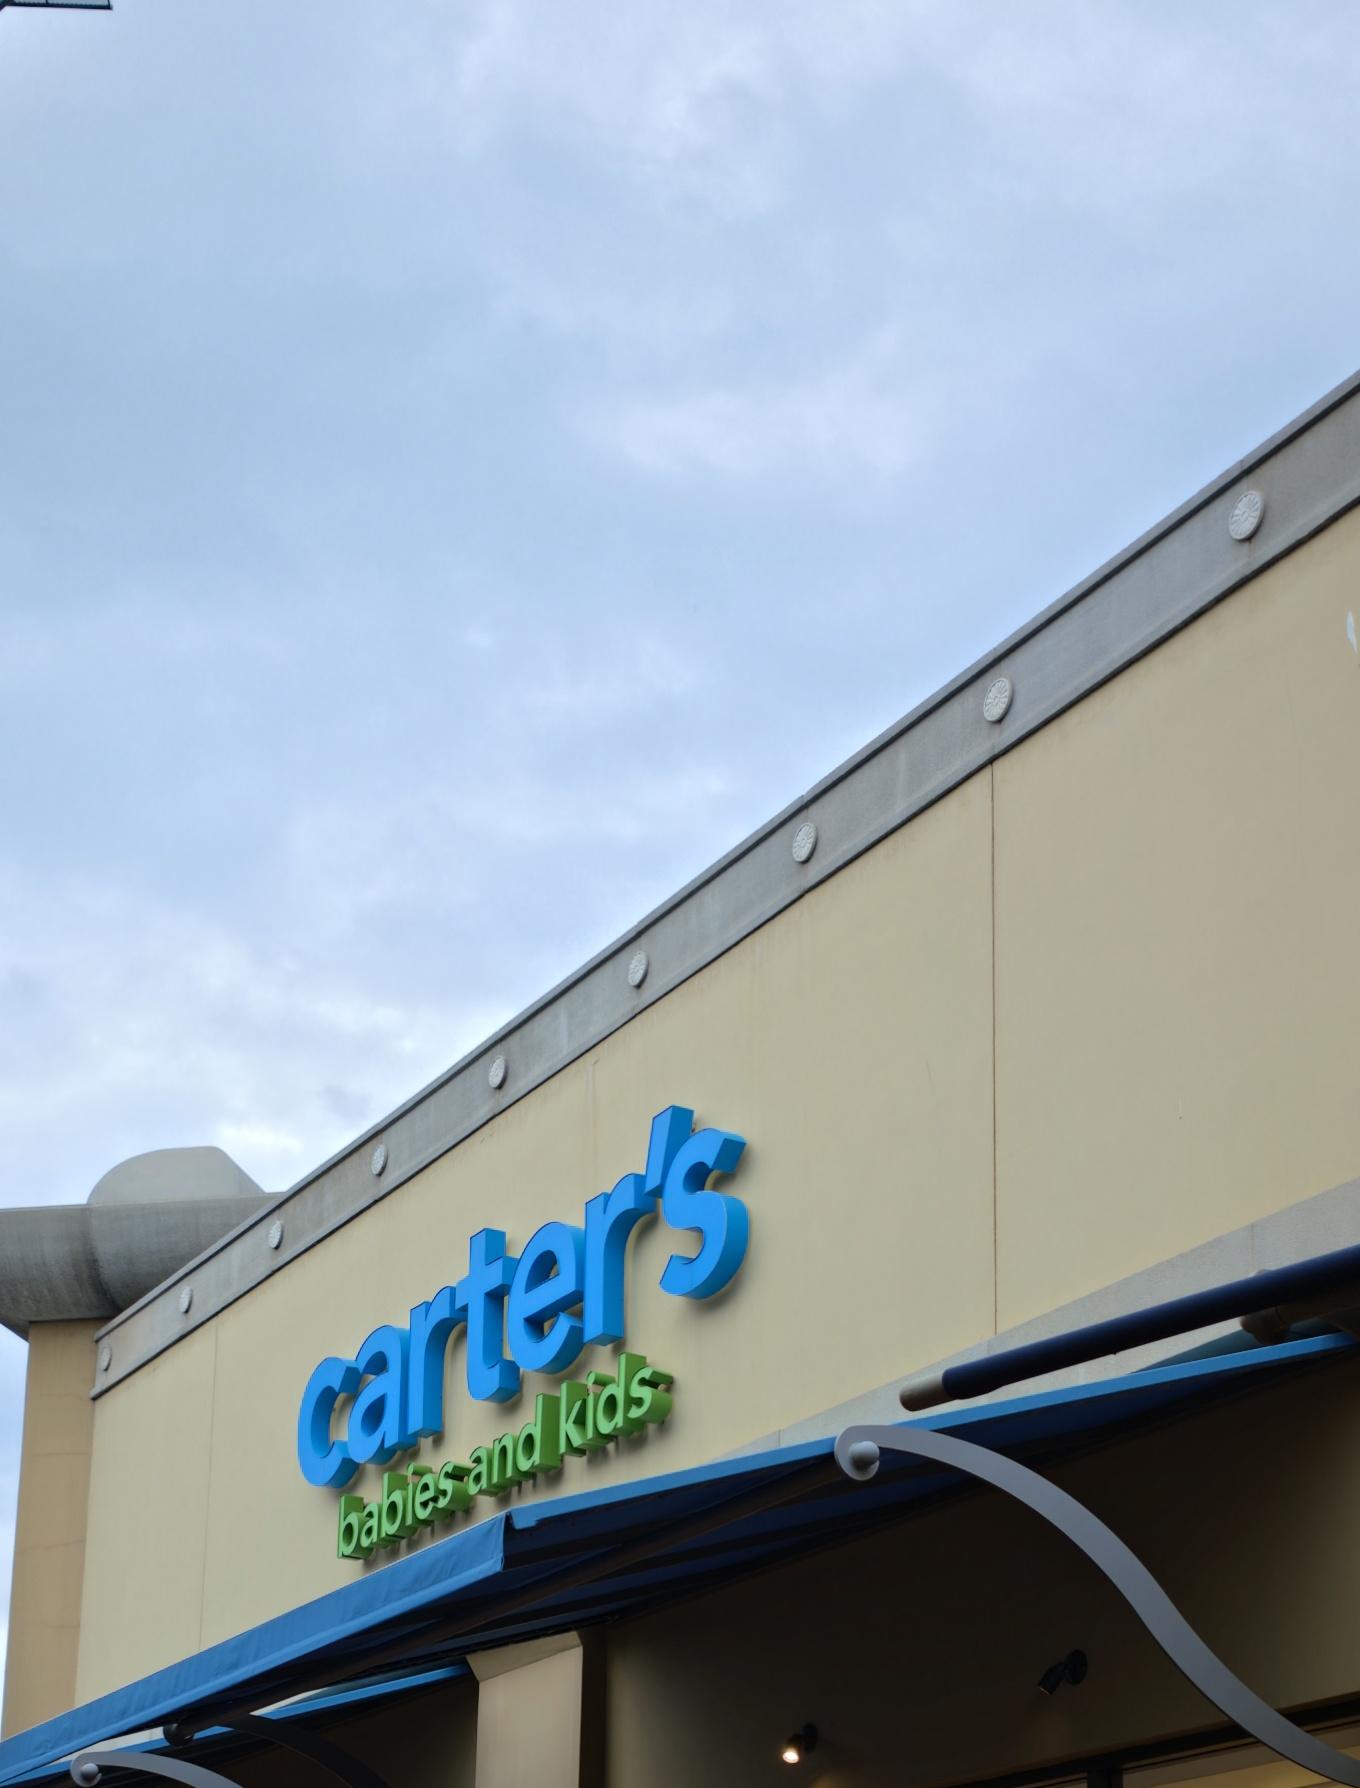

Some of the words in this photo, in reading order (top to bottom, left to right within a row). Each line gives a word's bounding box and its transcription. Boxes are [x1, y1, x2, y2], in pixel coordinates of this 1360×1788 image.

[298, 1105, 750, 1488] carter's
[337, 1461, 474, 1560] babies
[467, 1394, 563, 1497] and
[559, 1352, 674, 1457] kids
